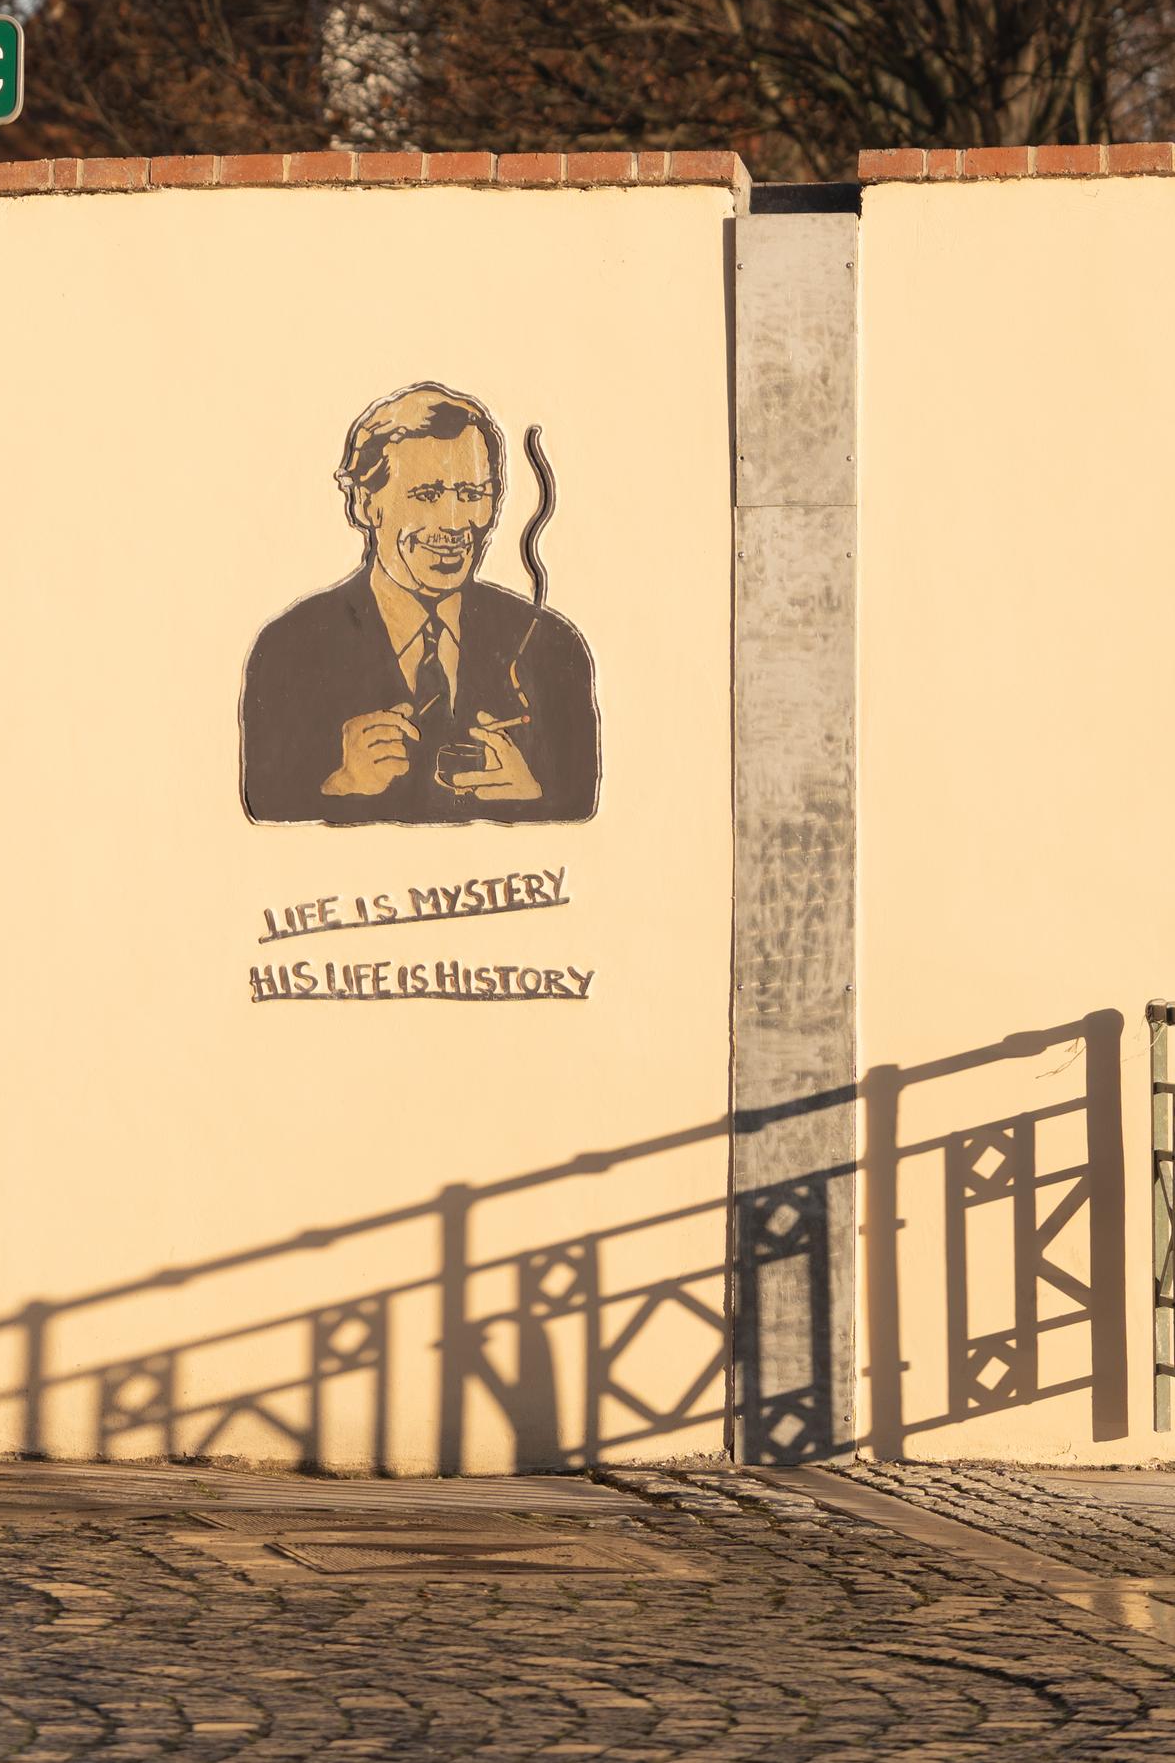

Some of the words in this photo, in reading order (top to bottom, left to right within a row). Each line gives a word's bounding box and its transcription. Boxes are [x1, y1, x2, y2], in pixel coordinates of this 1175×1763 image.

[262, 895, 343, 937] LIFE
[355, 894, 398, 926] IS
[407, 865, 567, 918] MYSTERY
[249, 960, 319, 998] HIS
[324, 960, 392, 998] LIFE
[398, 963, 430, 997] IS
[435, 960, 596, 999] HISTORY
